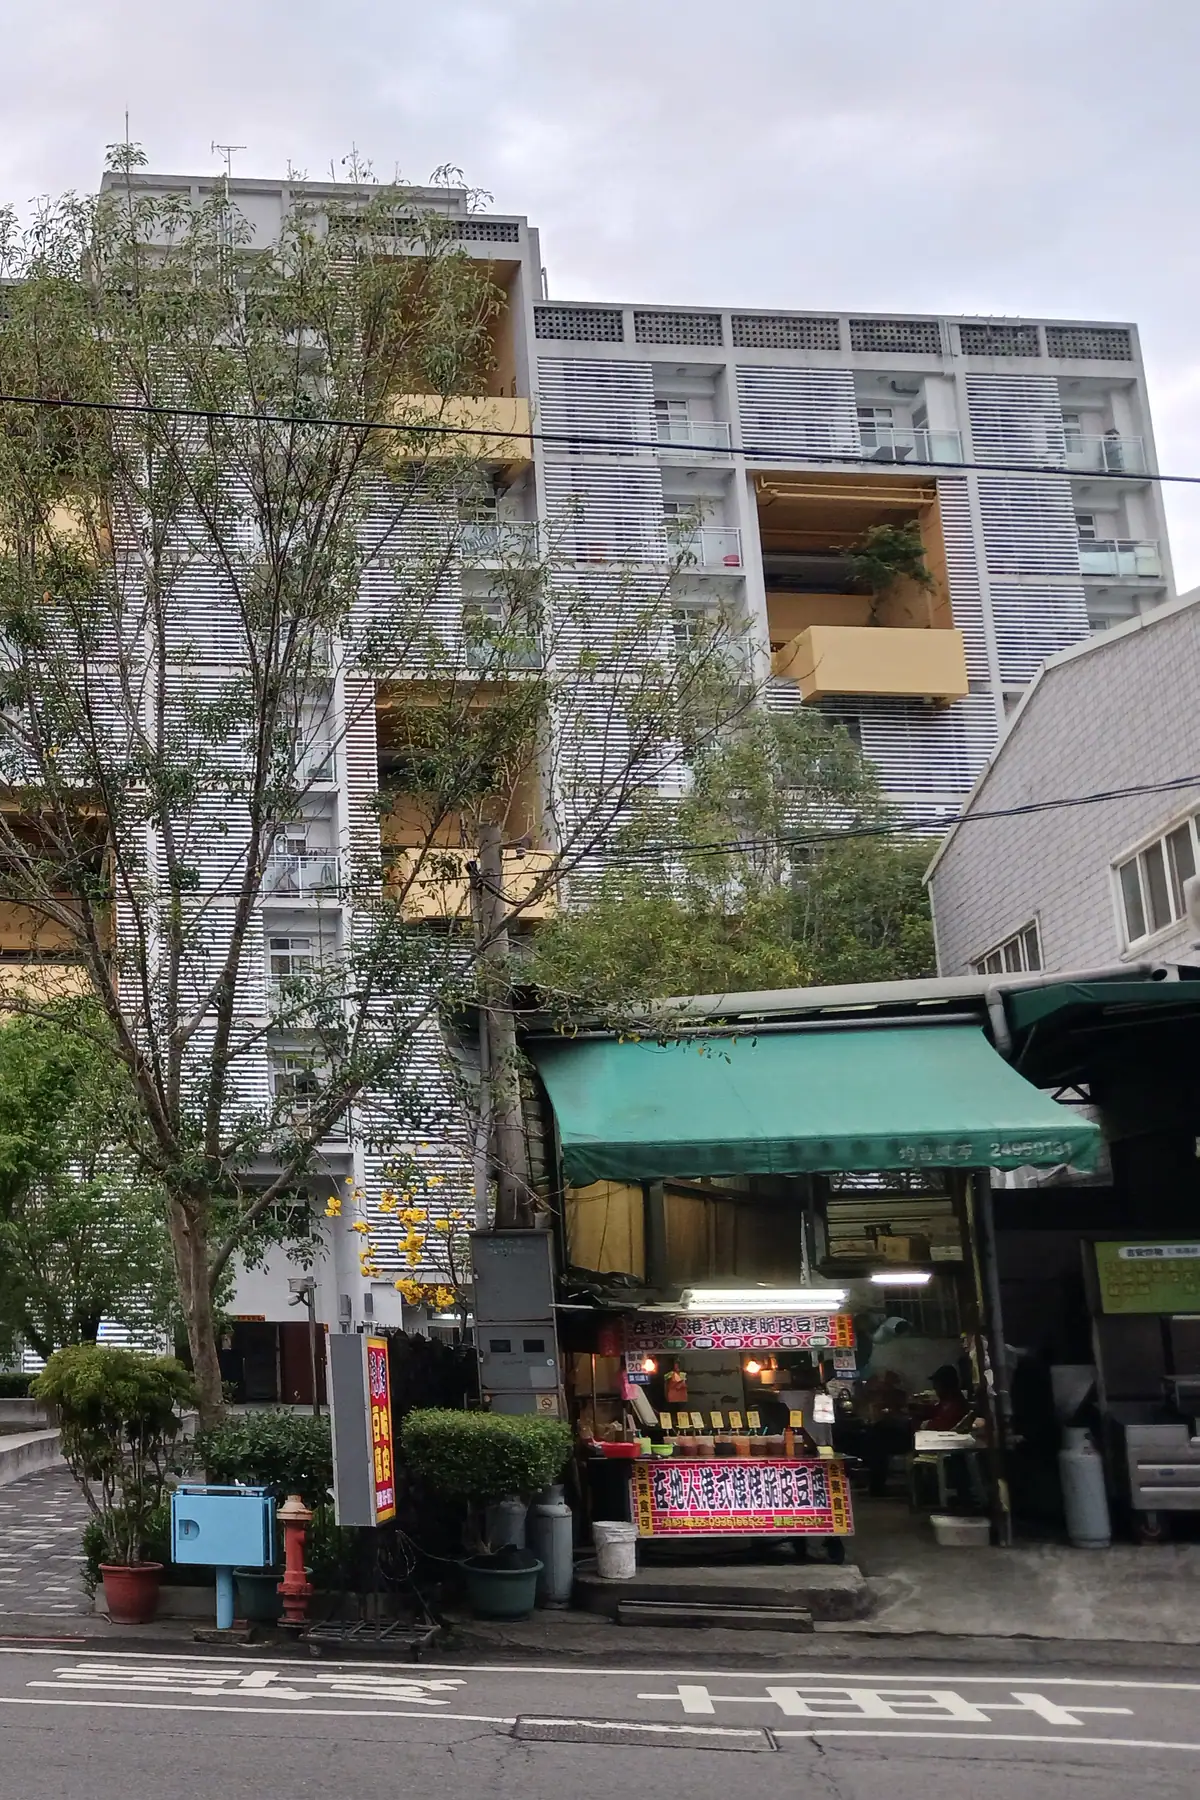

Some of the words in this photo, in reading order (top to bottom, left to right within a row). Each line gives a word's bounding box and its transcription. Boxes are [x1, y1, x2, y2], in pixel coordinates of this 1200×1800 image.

[633, 1315, 830, 1335] 在地人港式燒烤脆皮豆腐
[636, 1466, 650, 1529] 全素食可
[653, 1466, 827, 1509] 在地人港式燒烤脆皮豆腐
[829, 1465, 843, 1528] 全素食可
